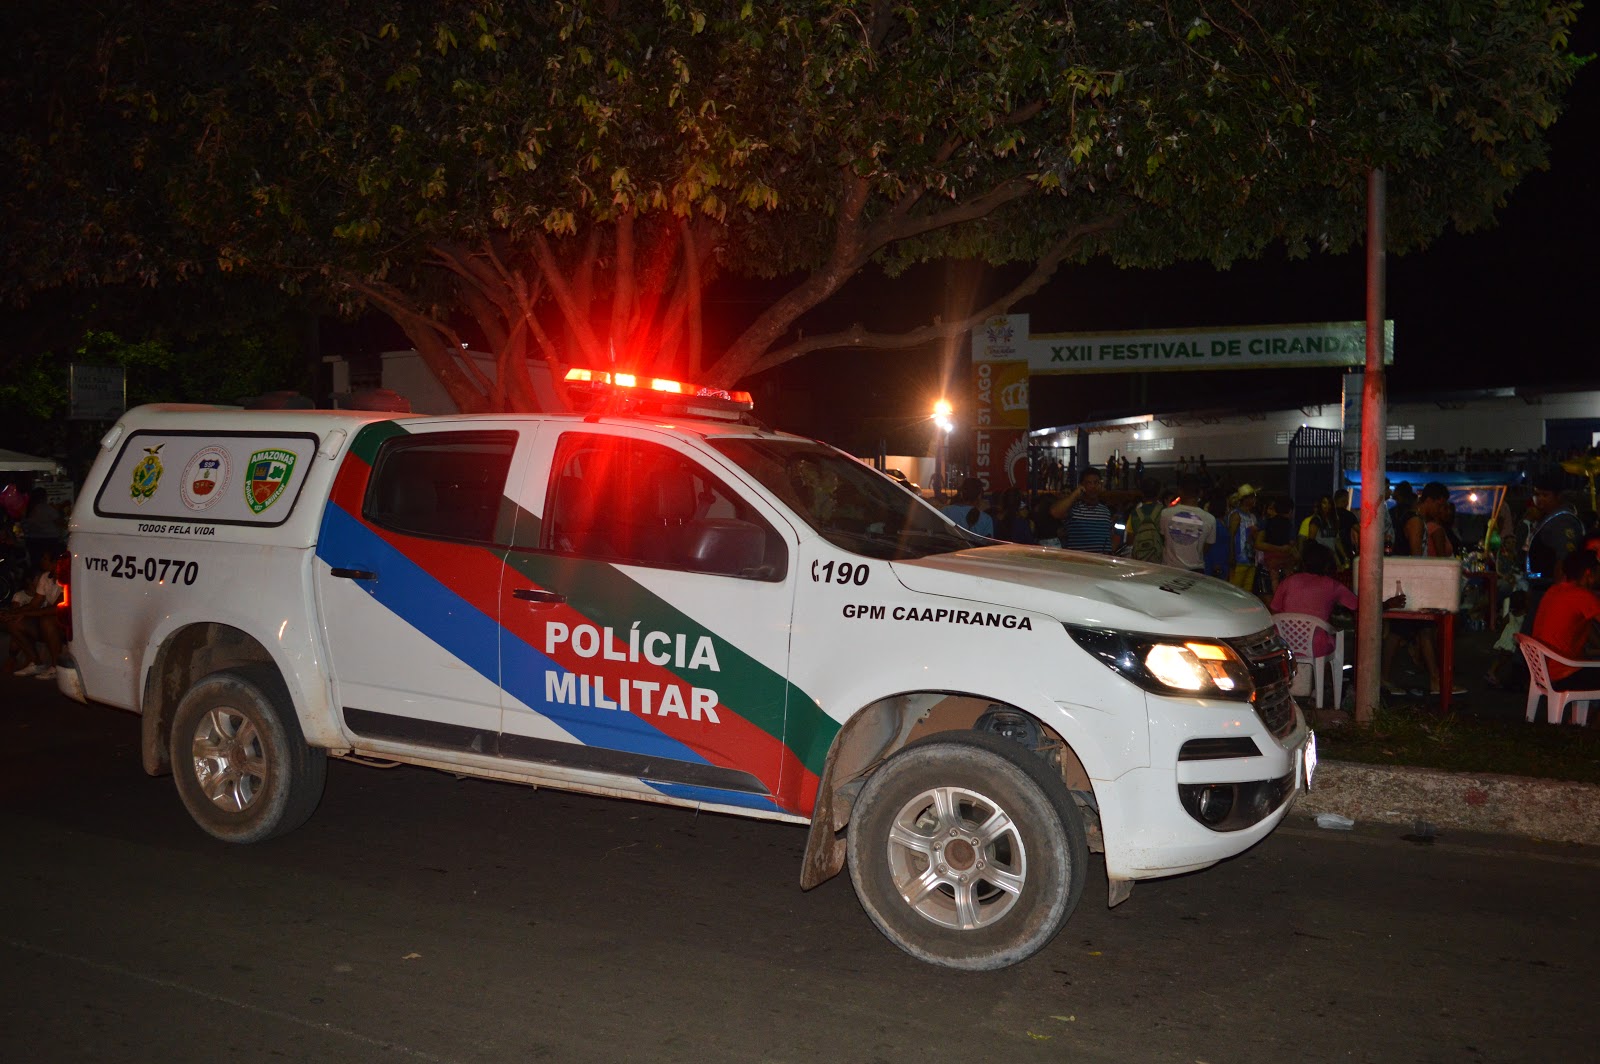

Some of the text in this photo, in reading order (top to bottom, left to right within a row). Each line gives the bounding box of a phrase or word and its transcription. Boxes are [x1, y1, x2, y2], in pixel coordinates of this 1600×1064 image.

[1050, 345, 1092, 362] XXII
[1099, 341, 1205, 361] FESTIVAL
[1211, 339, 1241, 357] DE
[978, 364, 992, 425] 31 AGO
[251, 451, 294, 465] AMAZONAS
[977, 431, 991, 467] SET
[265, 483, 286, 506] Militar
[138, 524, 215, 536] TODOS PELA VIDA
[85, 555, 199, 585] VTR 25-0770
[822, 561, 870, 586] 190
[842, 604, 1032, 631] GPM CAAPIRANGA
[545, 621, 721, 672] POLÍCIA
[545, 670, 721, 724] MILITAR
